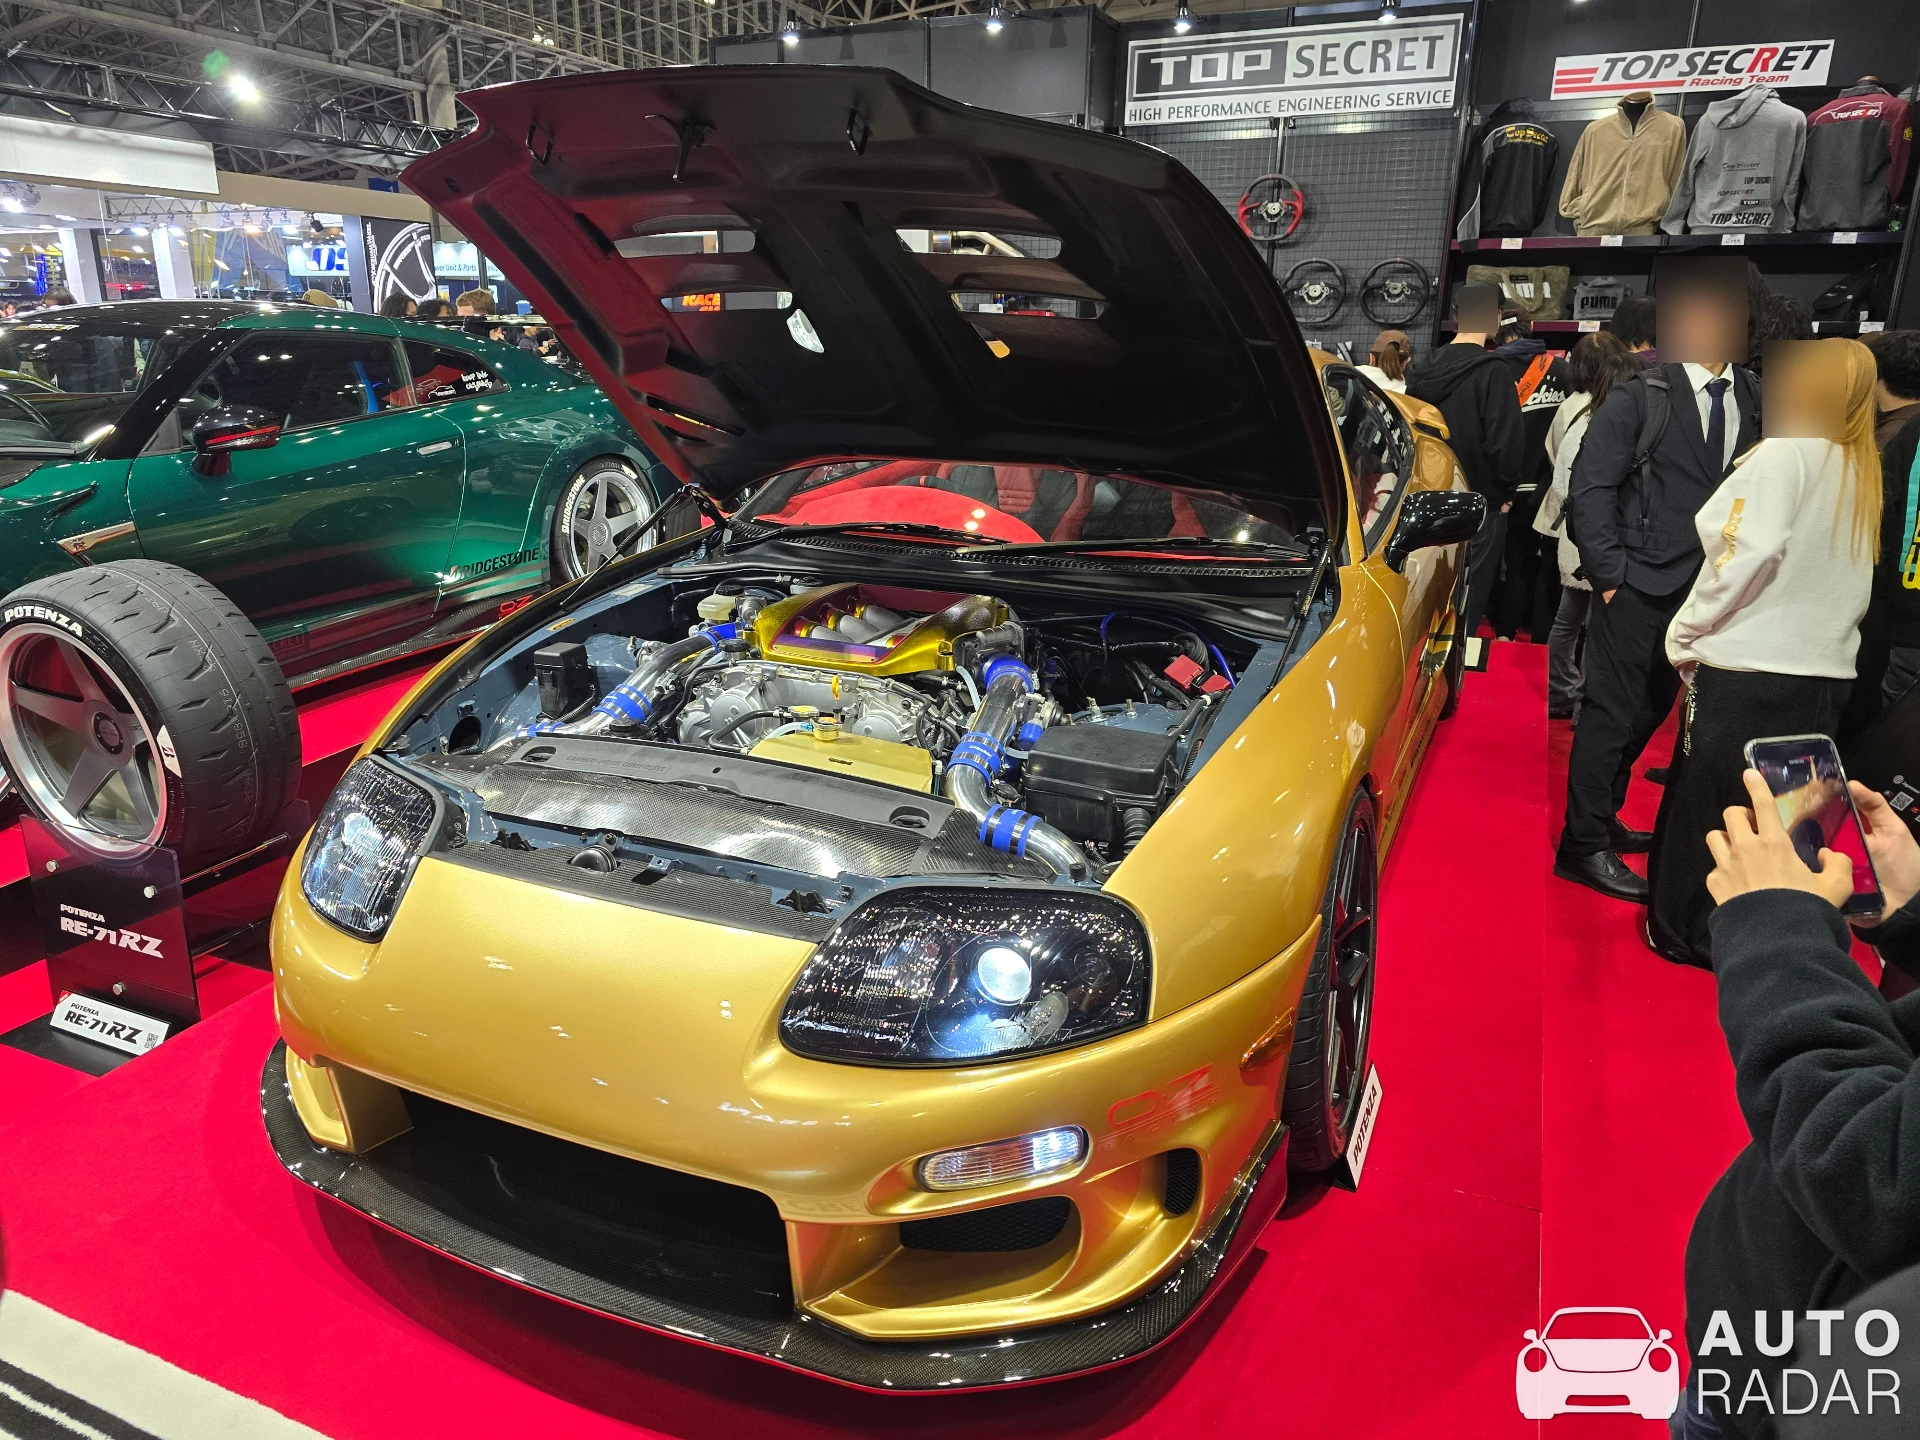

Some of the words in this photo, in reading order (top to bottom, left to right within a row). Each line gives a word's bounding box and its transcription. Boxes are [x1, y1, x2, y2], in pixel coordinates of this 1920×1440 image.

[1150, 48, 1272, 85] TOP
[1292, 35, 1445, 78] SECRET
[1688, 75, 1744, 88] Racing
[1748, 73, 1790, 85] Team
[1128, 107, 1162, 122] HIGH
[1167, 100, 1272, 120] PERFORMANCE
[1277, 93, 1381, 113] ENGINEERING
[1385, 89, 1452, 106] SERVICE
[462, 263, 477, 272] Parts
[450, 547, 540, 579] BRIDGESTONE
[4, 604, 84, 638] POTENZA
[60, 903, 105, 923] POTENZA
[60, 916, 164, 959] RE-71RZ
[70, 1002, 100, 1016] POTENZA
[63, 1009, 143, 1046] RE-71RZ
[1353, 1084, 1378, 1167] POTENZA
